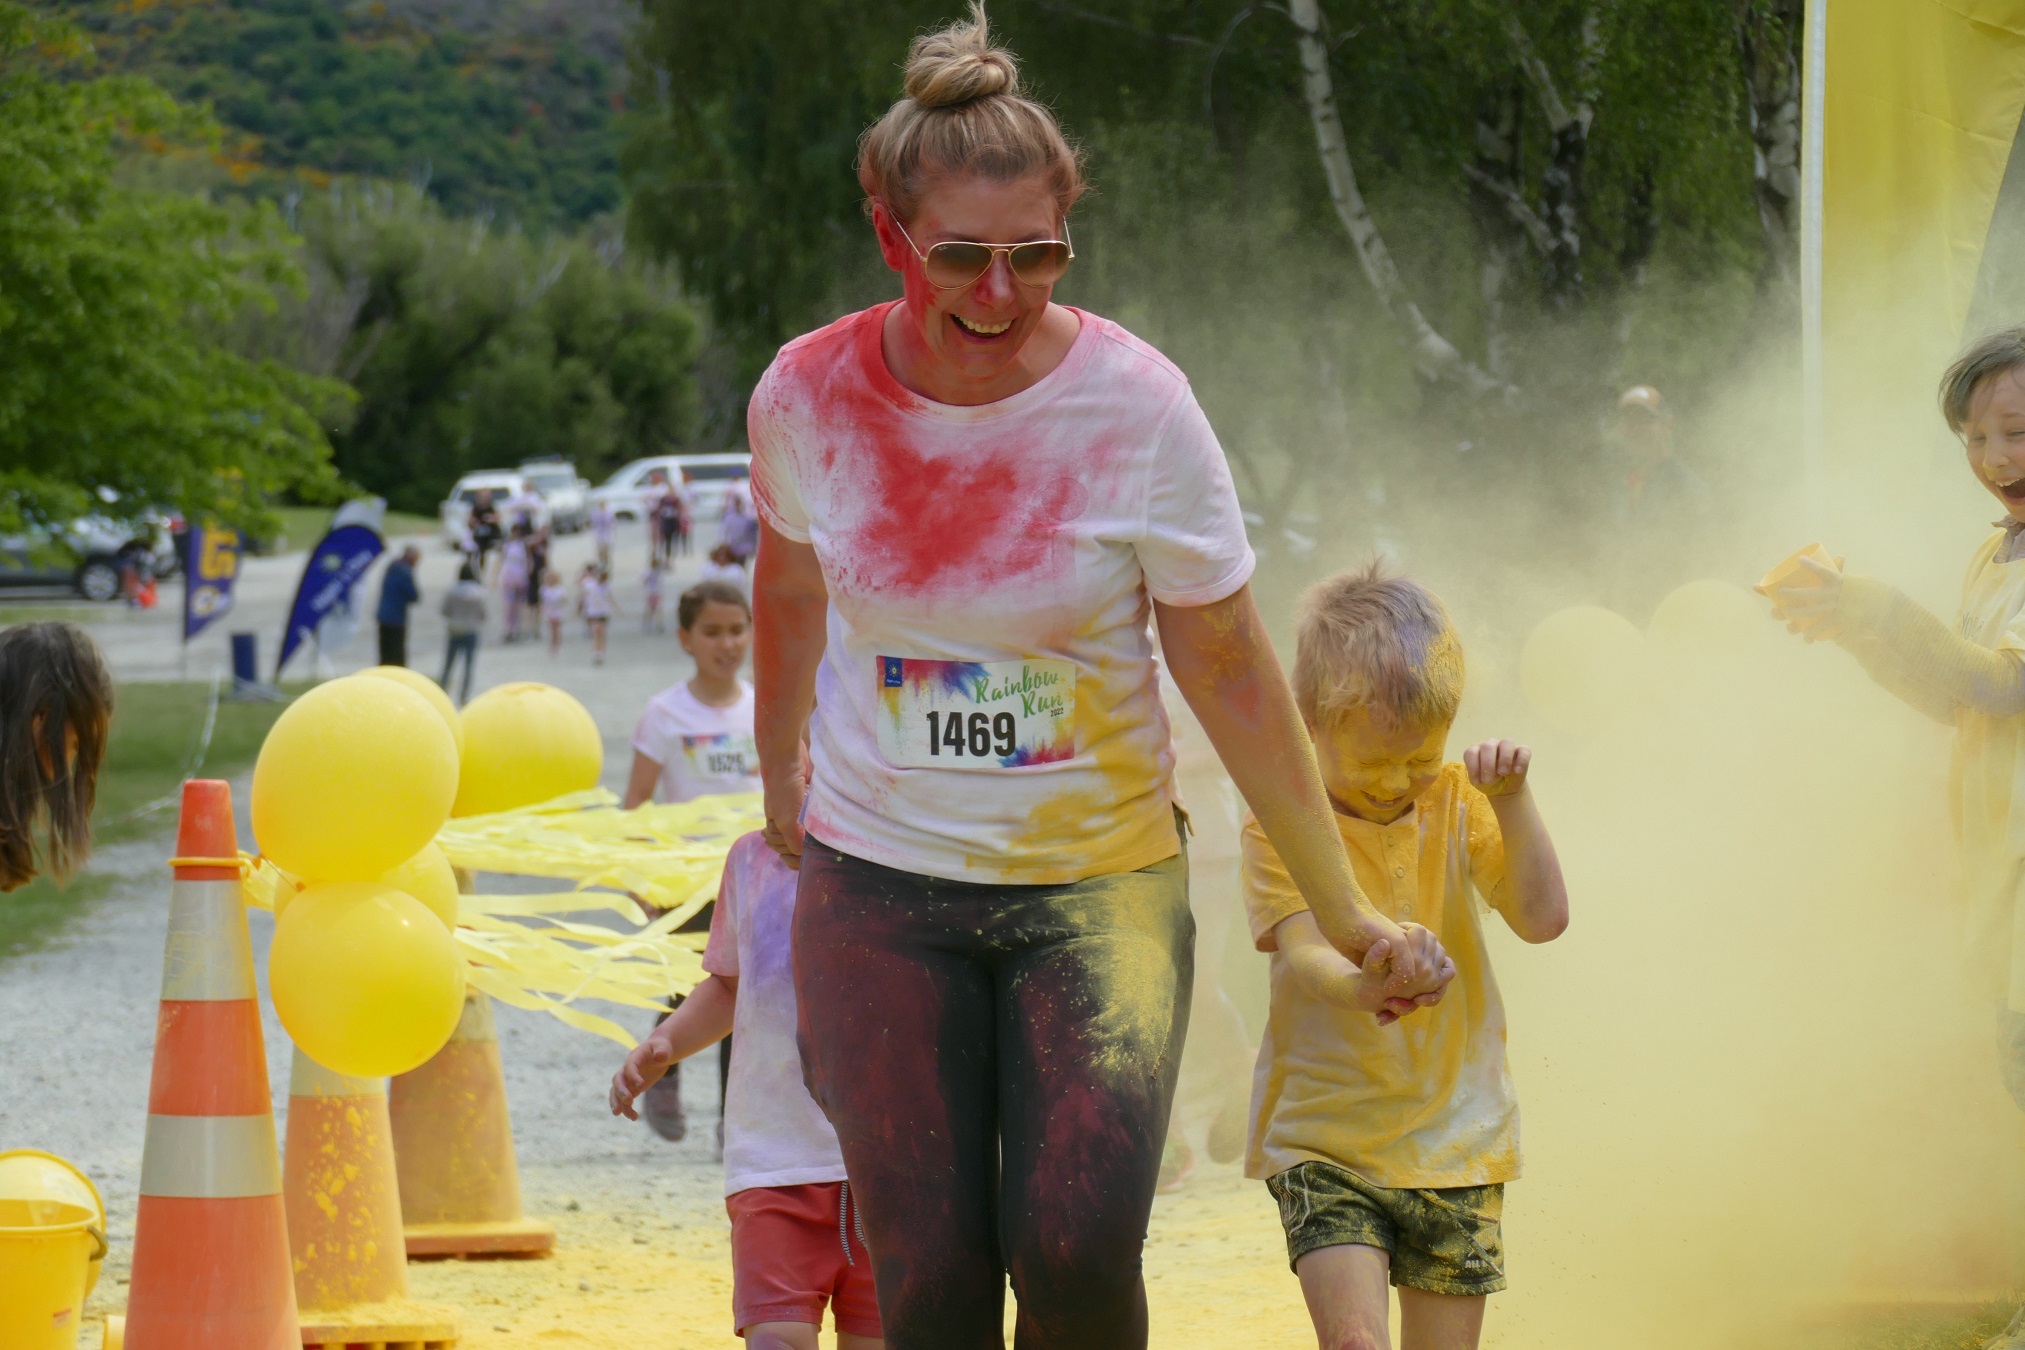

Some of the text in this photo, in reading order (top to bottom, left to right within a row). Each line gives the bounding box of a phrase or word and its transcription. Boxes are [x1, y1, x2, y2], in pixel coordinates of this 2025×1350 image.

[974, 665, 1059, 704] Rainbow
[1021, 691, 1063, 718] Run
[926, 711, 1016, 757] 1469
